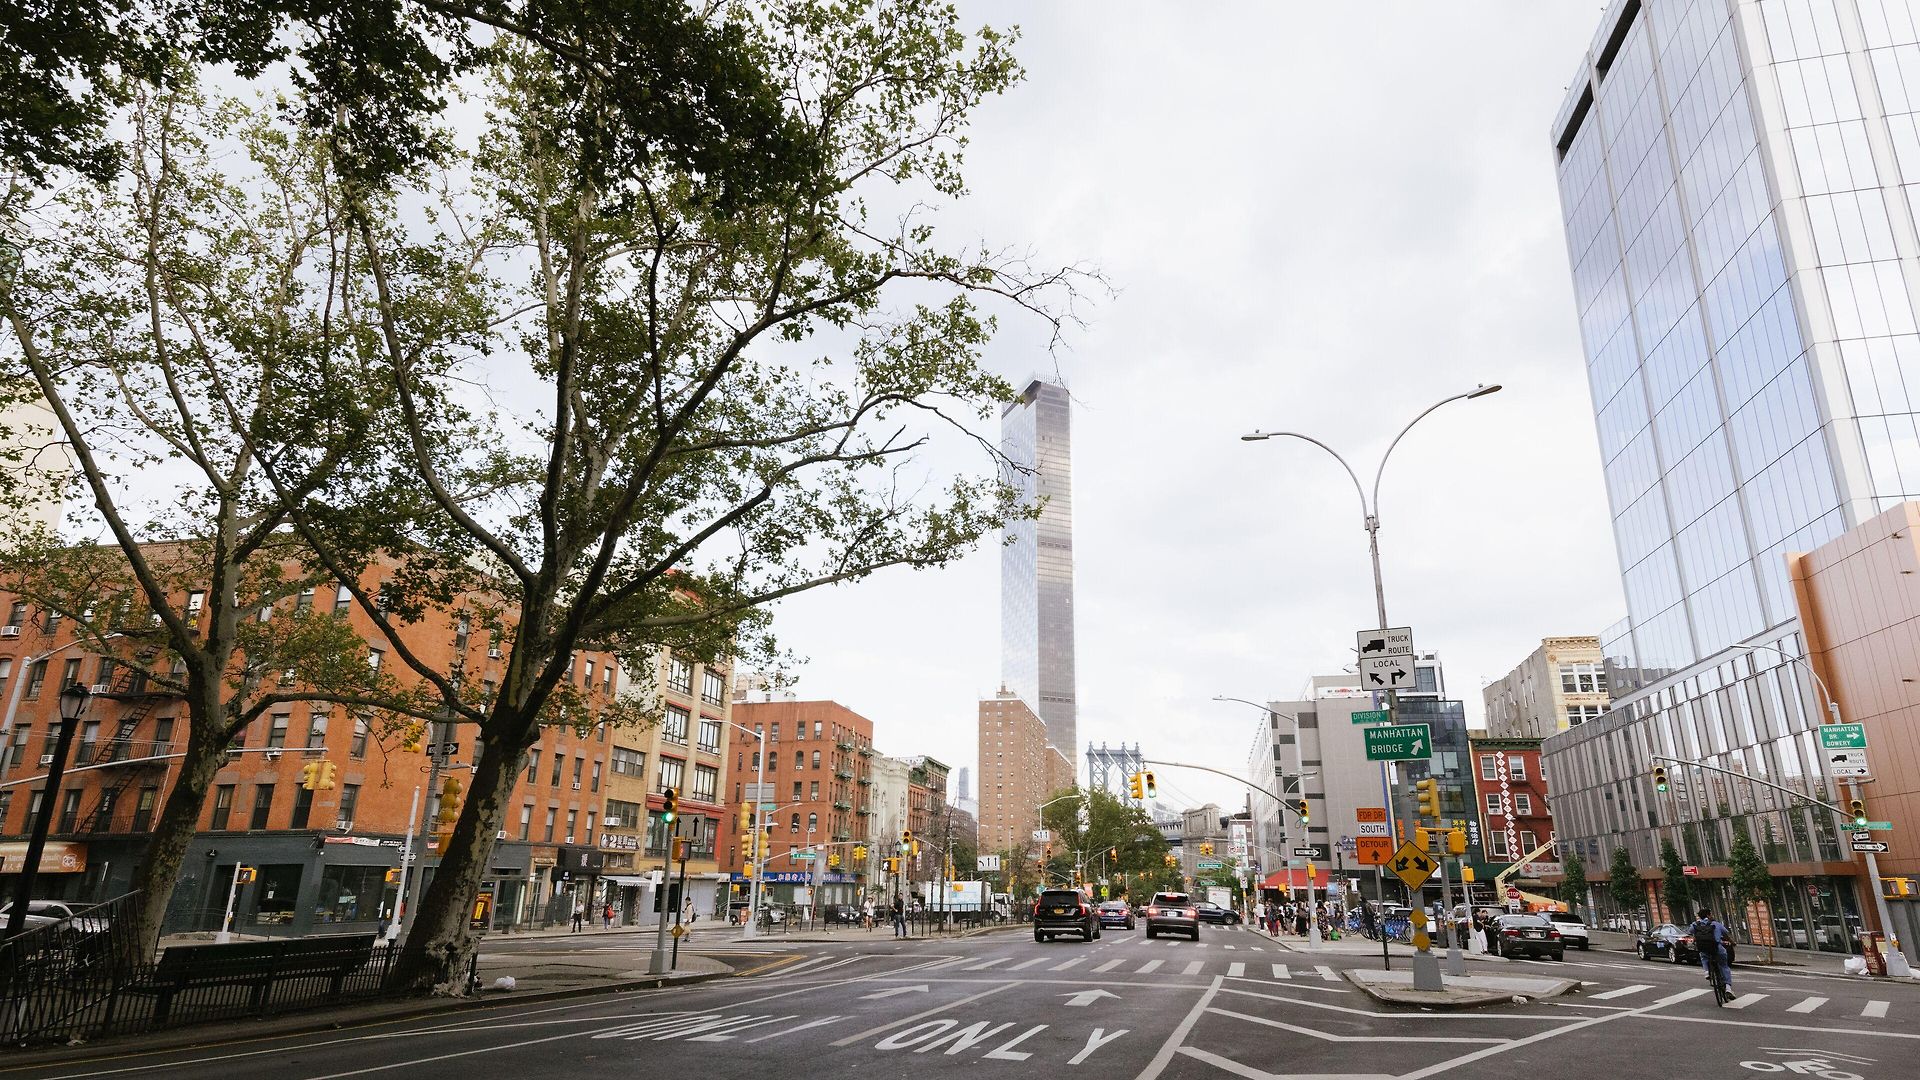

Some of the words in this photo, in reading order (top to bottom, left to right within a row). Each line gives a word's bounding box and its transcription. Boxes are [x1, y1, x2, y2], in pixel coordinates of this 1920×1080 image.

[1388, 646, 1409, 654] ROUTE
[1373, 660, 1400, 668] LOCAL
[1353, 712, 1380, 720] DIVISION
[1370, 728, 1423, 739] MANHATTAN
[1371, 744, 1404, 754] BRIDGE
[1361, 825, 1385, 833] SOUTH
[874, 1019, 1130, 1065] ONLY
